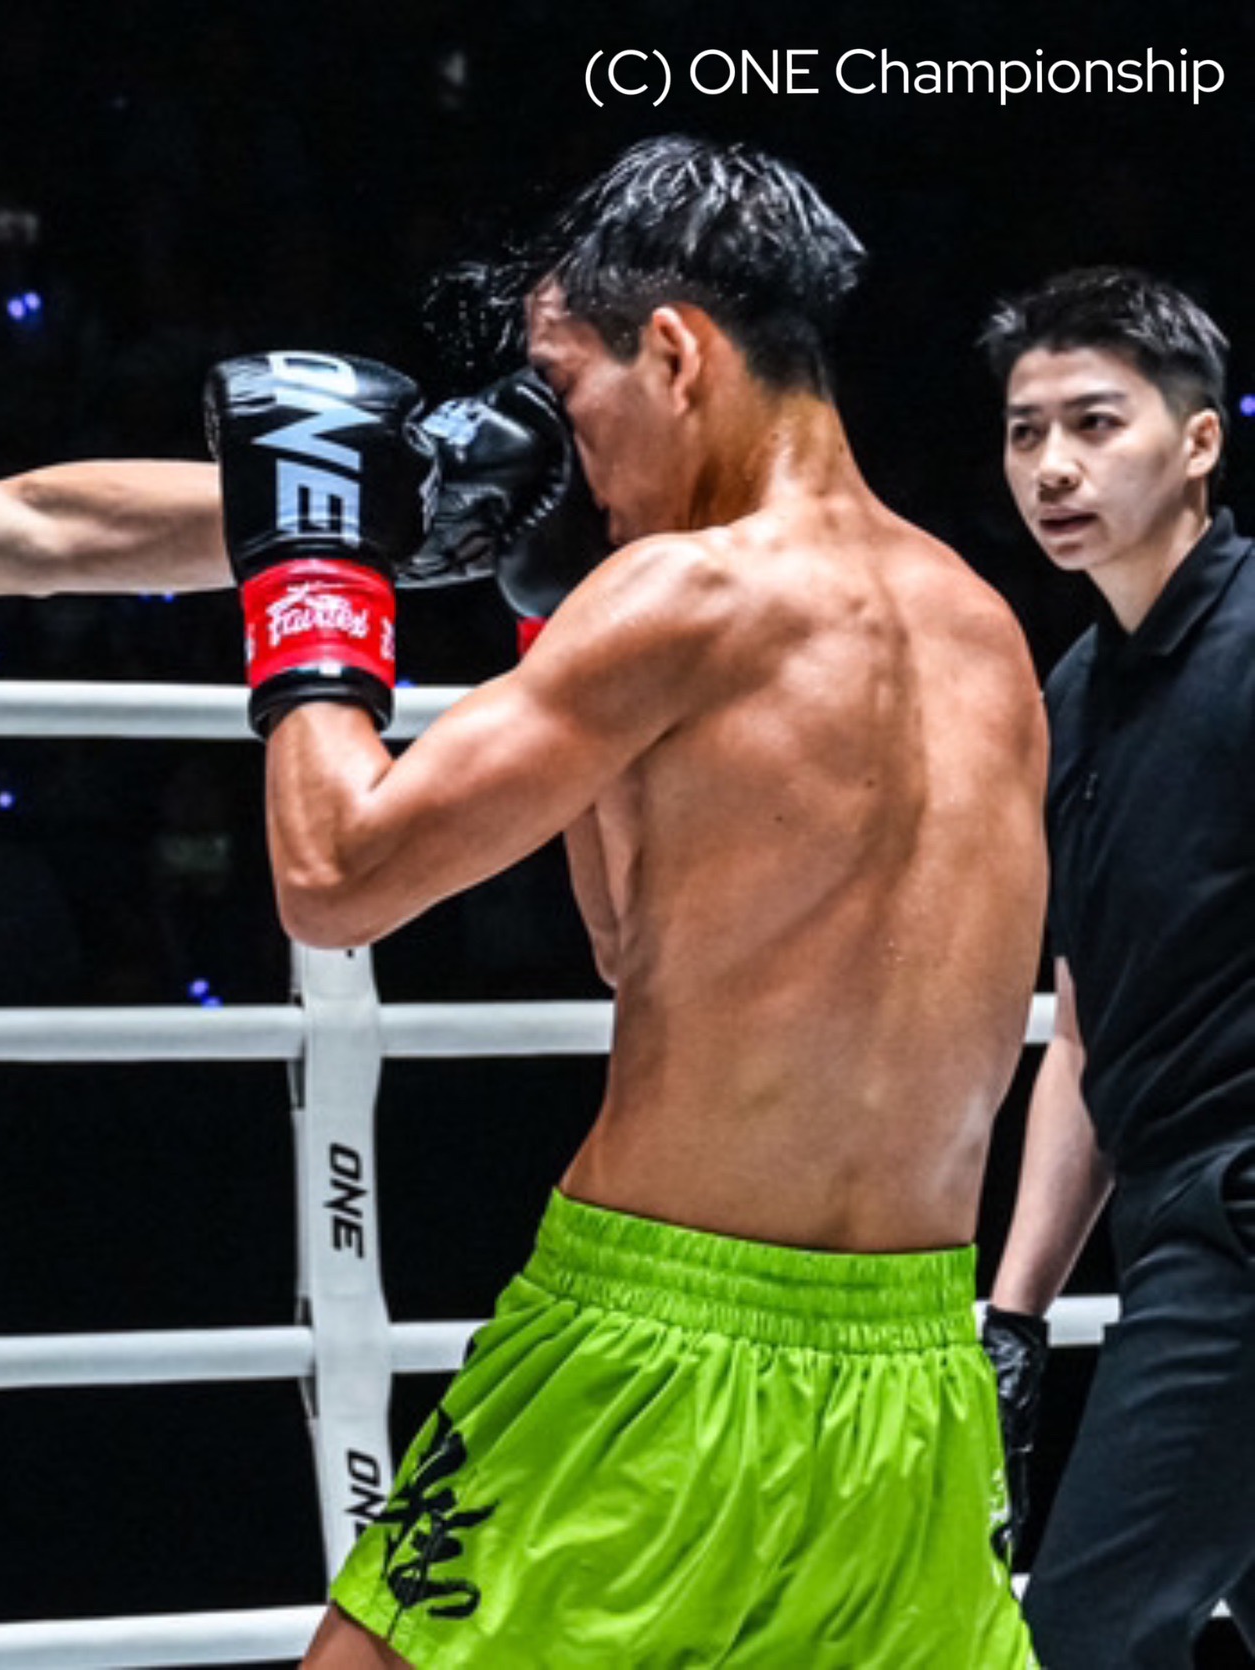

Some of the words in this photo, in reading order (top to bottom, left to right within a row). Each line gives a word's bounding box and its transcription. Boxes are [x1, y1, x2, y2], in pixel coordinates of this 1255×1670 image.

[251, 351, 384, 545] ONE
[324, 1142, 369, 1259] ONE
[345, 1448, 389, 1541] ON
